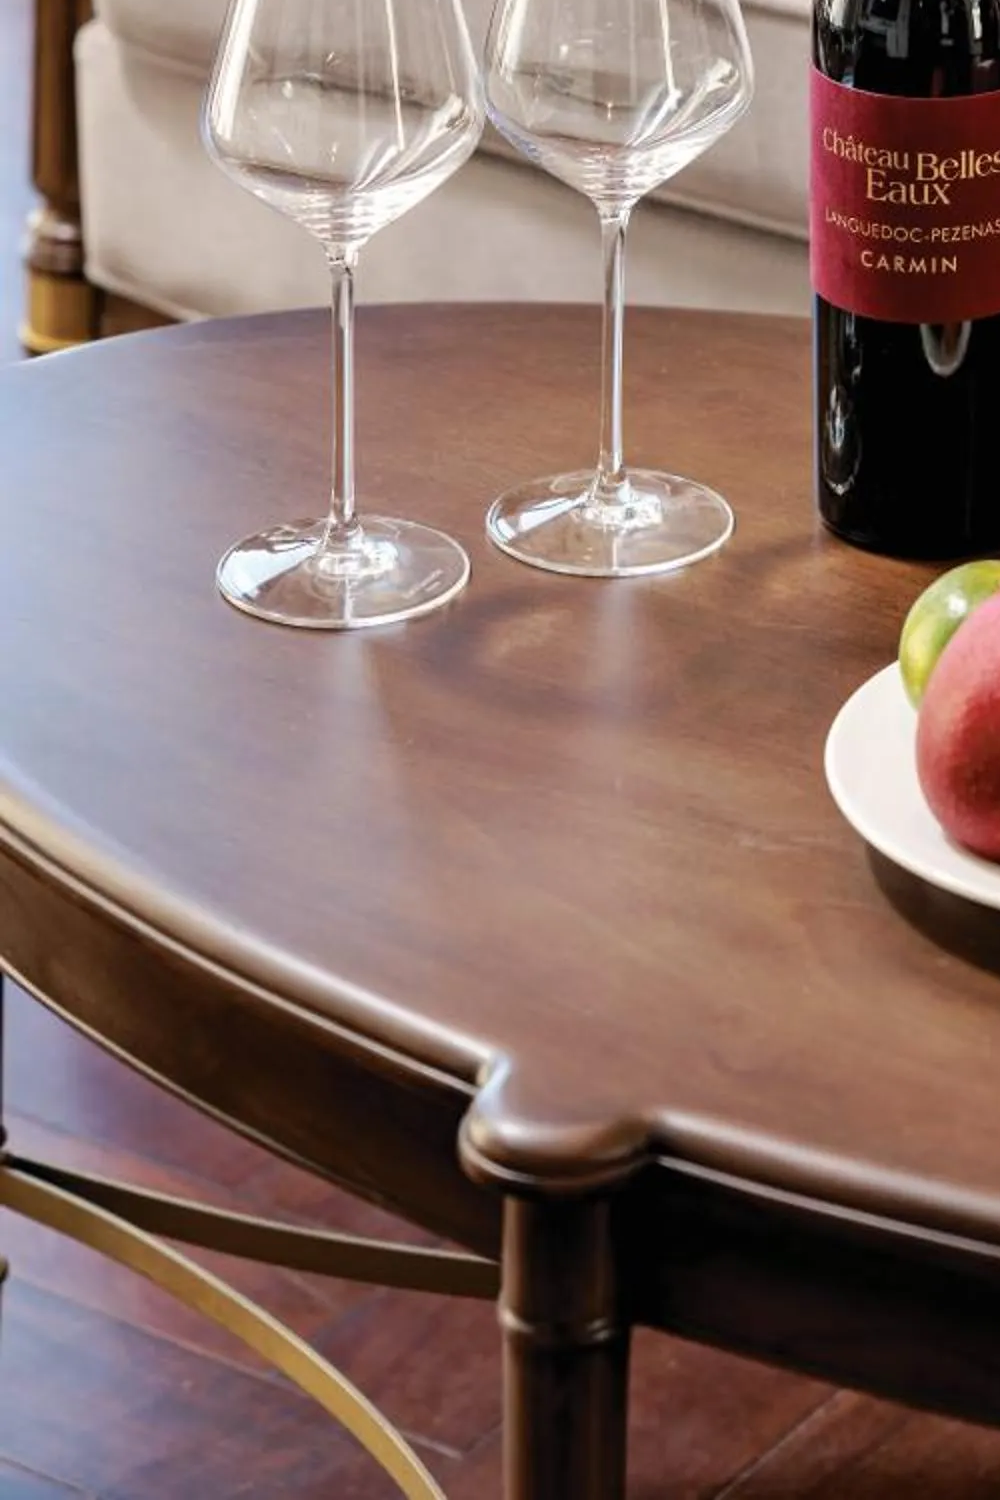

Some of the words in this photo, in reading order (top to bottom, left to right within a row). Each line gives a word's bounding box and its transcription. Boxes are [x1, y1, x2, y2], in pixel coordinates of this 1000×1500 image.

[823, 126, 909, 170] Château
[866, 167, 951, 205] Eaux
[860, 250, 957, 274] CARMIN
